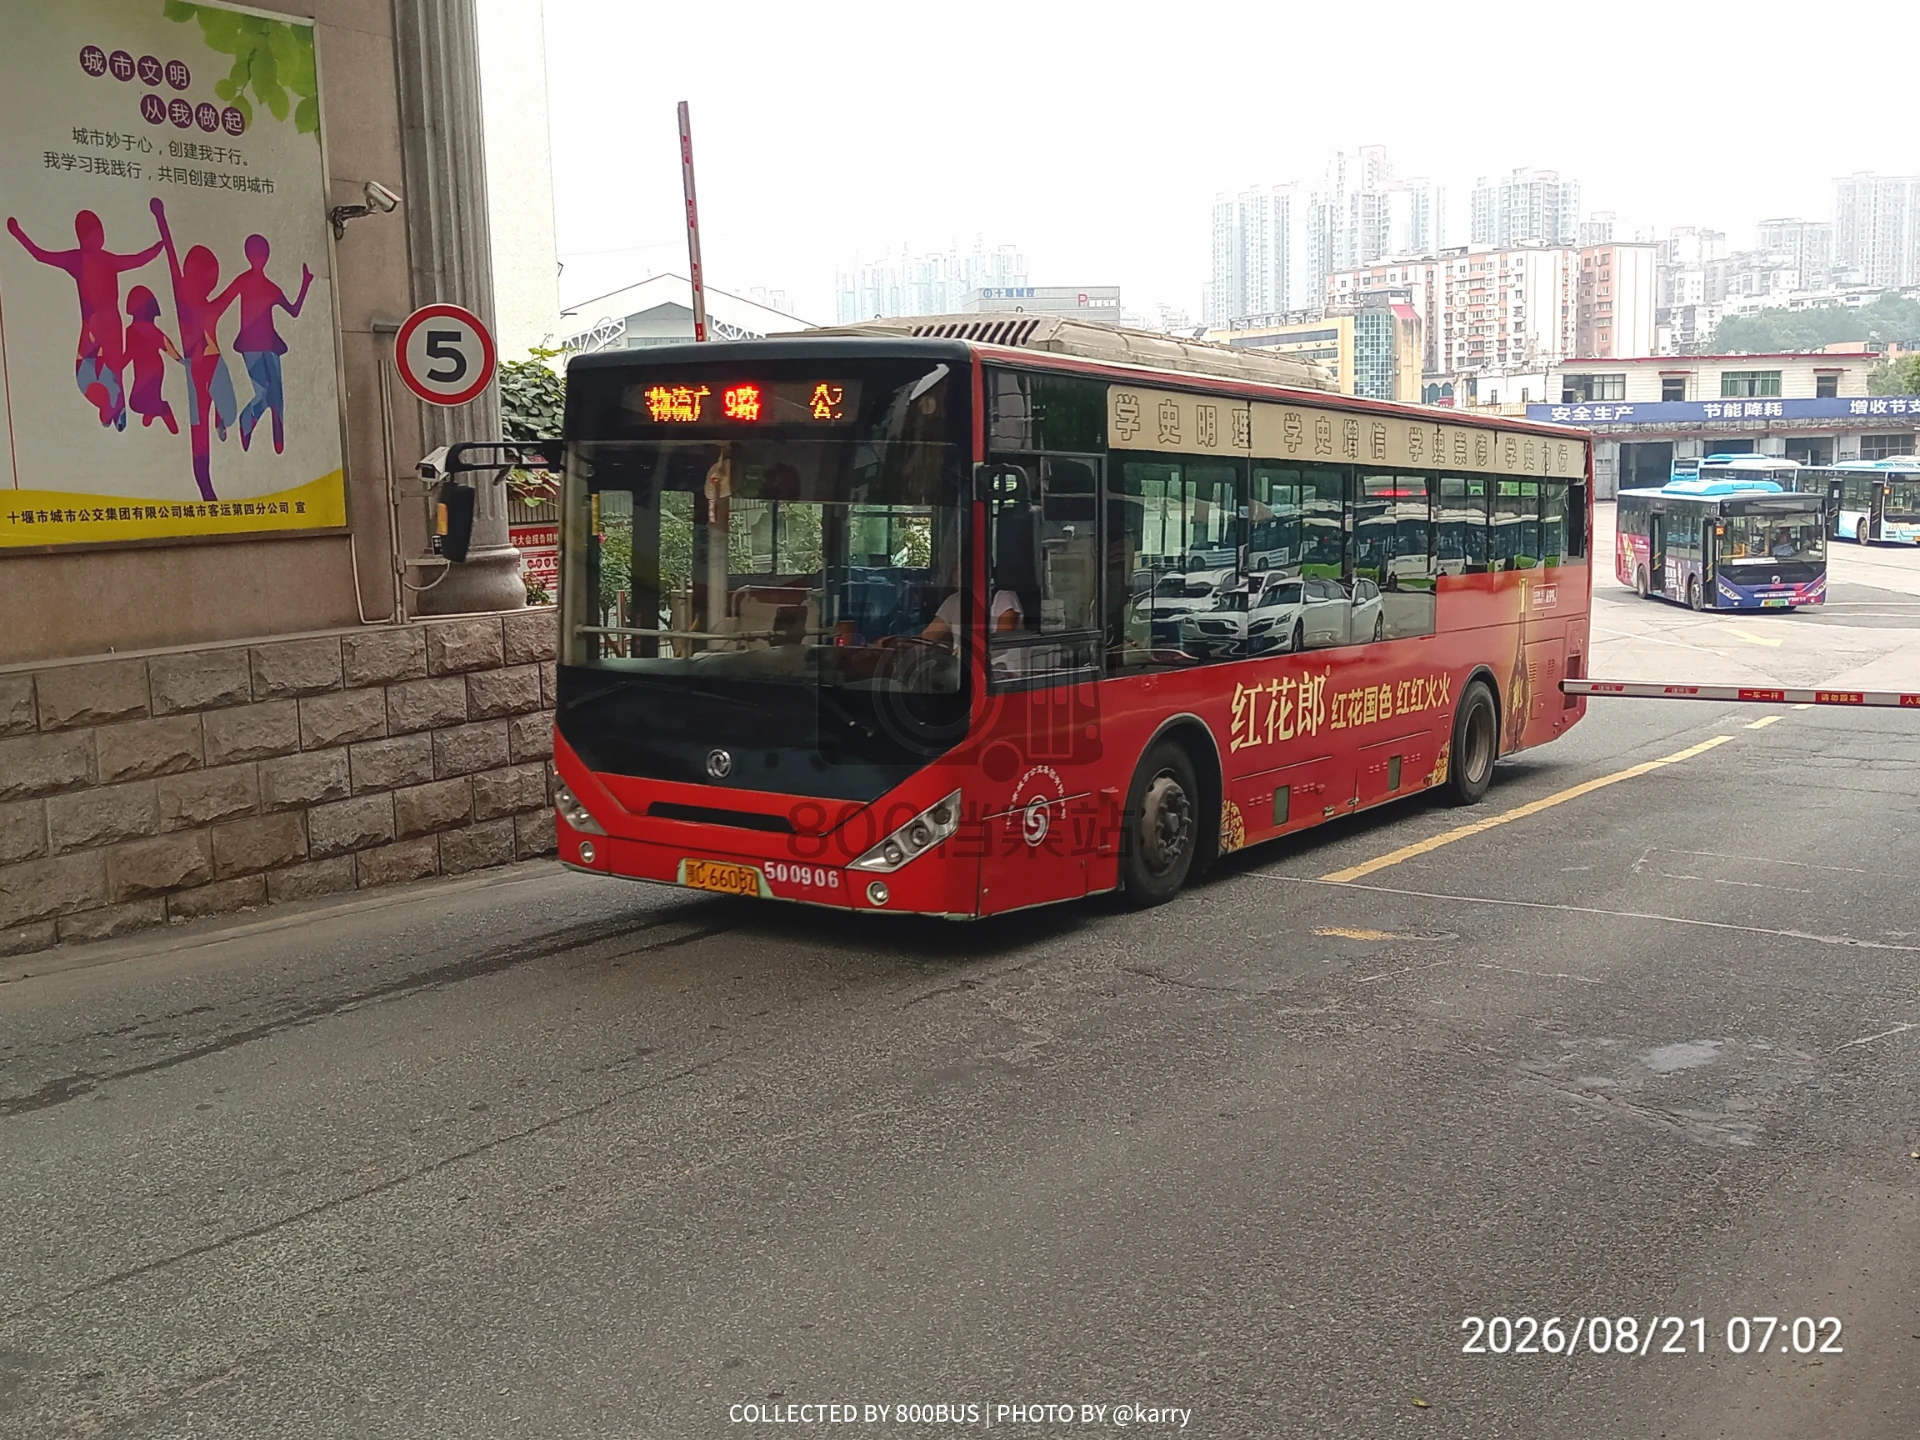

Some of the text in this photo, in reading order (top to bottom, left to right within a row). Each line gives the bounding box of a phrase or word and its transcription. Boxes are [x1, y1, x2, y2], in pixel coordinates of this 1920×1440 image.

[83, 48, 188, 87] 城市文明
[144, 97, 244, 133] 从我做起
[426, 330, 467, 383] 5
[1551, 399, 1920, 422] 安全生产 节能降耗 增收节支
[1115, 393, 1569, 473] 学史明理 学史增信 学史崇德 学史力行
[6, 500, 307, 525] 十堰市城市公交集团有限公司城市客运第四分公司 宣
[1229, 670, 1452, 754] 红花郎 红花国色 红红火火
[763, 861, 839, 888] 500906
